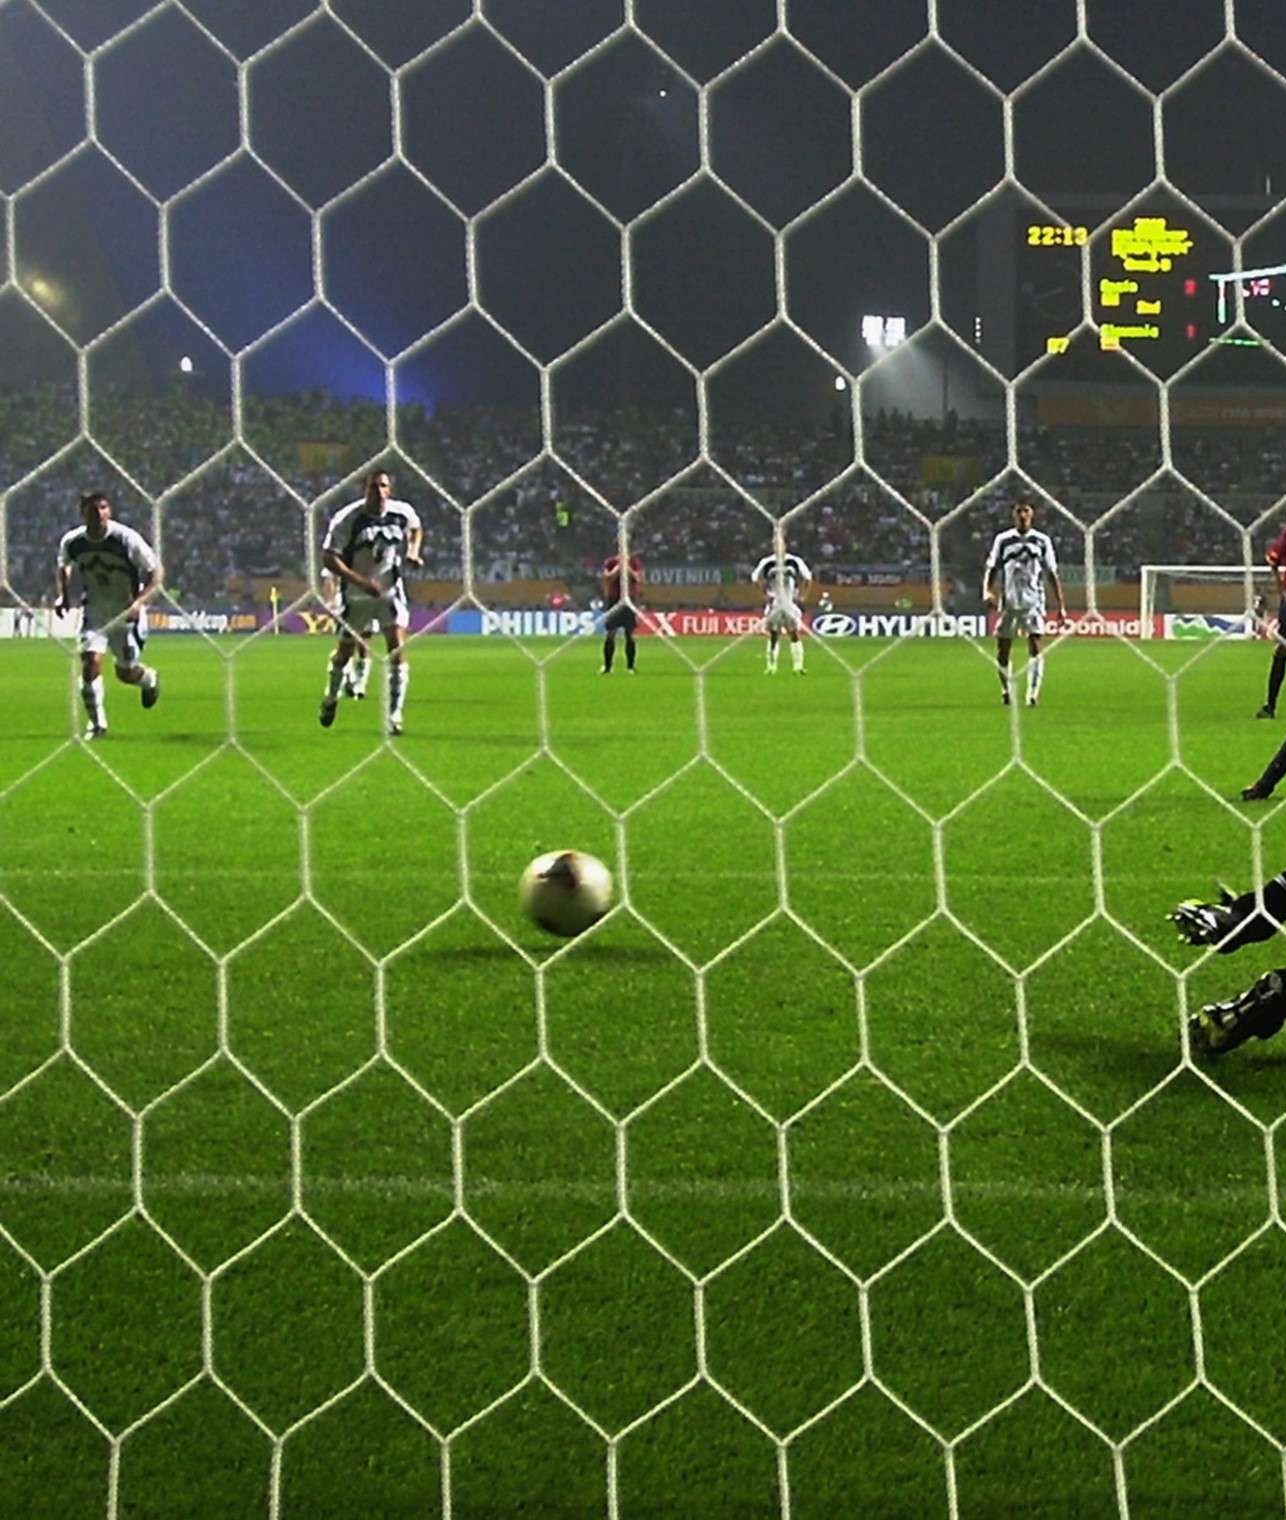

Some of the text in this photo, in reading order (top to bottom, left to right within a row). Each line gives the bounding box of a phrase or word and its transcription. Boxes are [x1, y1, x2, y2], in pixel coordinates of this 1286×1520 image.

[1028, 226, 1088, 245] 22:13
[481, 611, 596, 636] PHILIPS
[683, 616, 719, 634] FUJI
[858, 615, 987, 637] HYUNDAI
